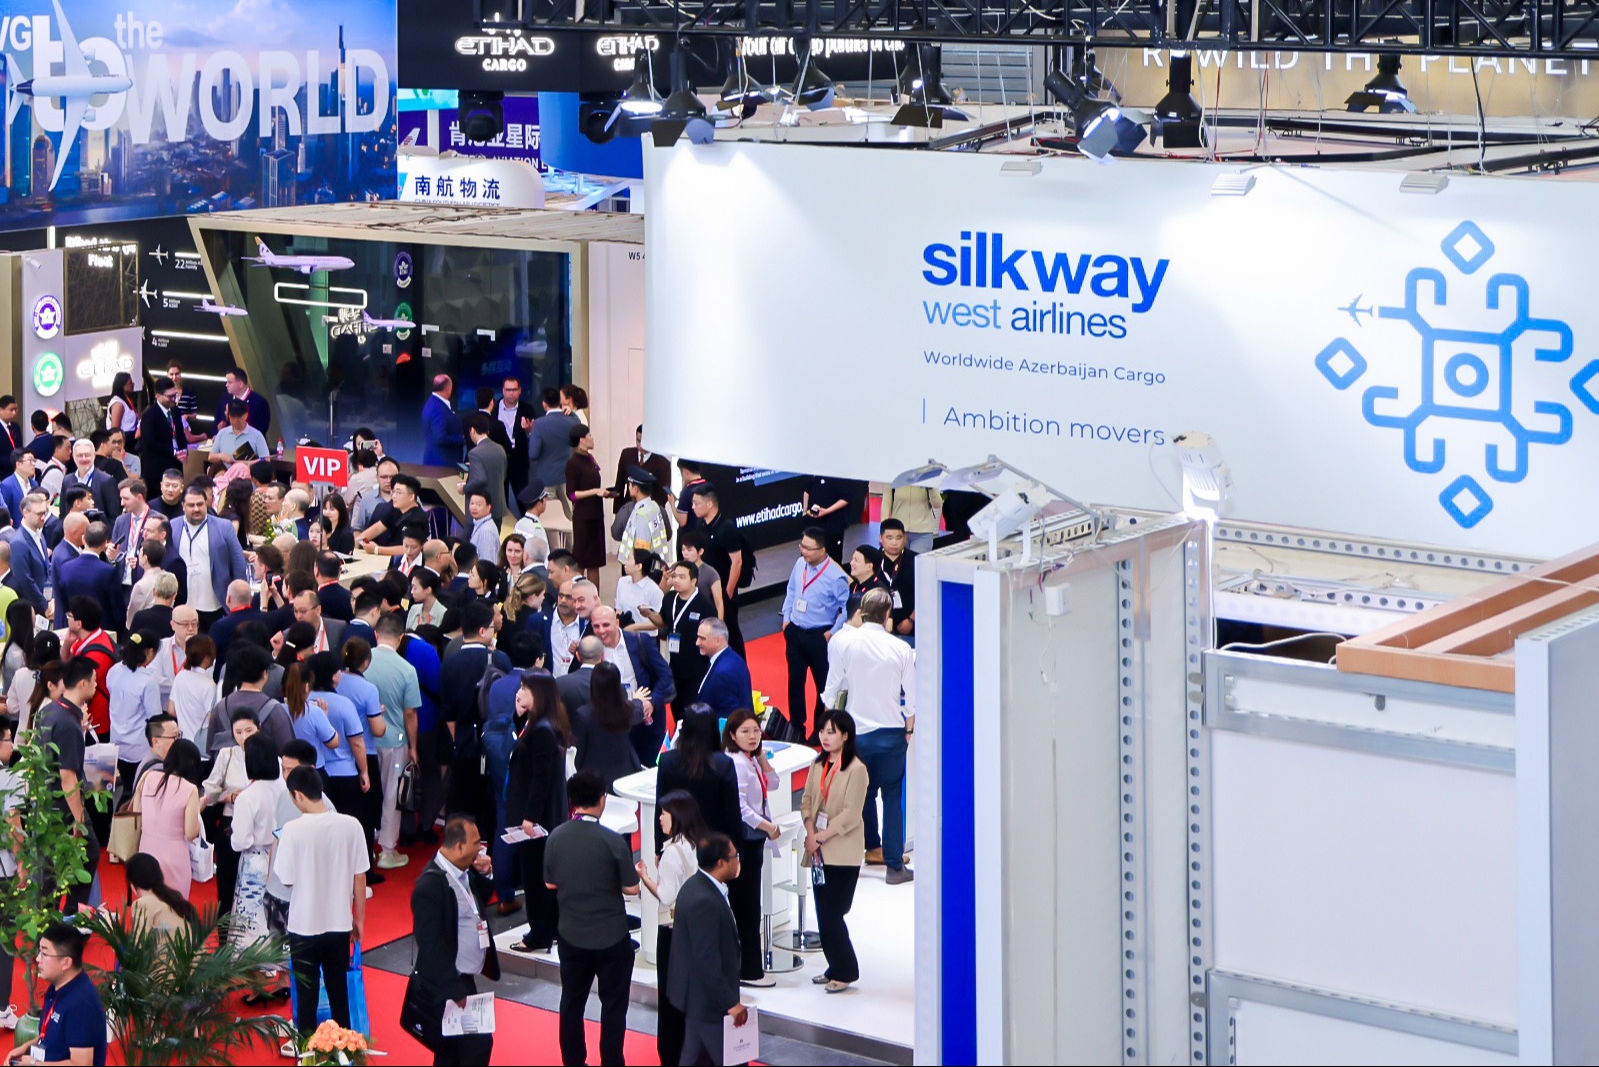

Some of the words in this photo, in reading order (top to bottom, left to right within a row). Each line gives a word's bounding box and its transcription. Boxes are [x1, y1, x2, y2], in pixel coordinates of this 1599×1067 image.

[114, 11, 164, 50] the
[455, 36, 555, 55] ETIHAD
[482, 57, 527, 72] CARGO
[1143, 47, 1299, 69] RWILD
[125, 48, 390, 145] WORLD
[414, 175, 501, 200] 南航物流
[174, 259, 185, 269] 22
[628, 251, 641, 261] W5
[921, 230, 1171, 314] silkway
[162, 297, 169, 308] 5
[922, 299, 1001, 329] west
[1011, 300, 1127, 339] airlines
[923, 350, 1014, 371] Worldwide
[1018, 358, 1109, 381] Azerbaijan
[1113, 367, 1166, 386] Cargo
[943, 407, 1061, 436] Ambition
[1070, 421, 1166, 446] movers
[303, 455, 341, 477] VIP
